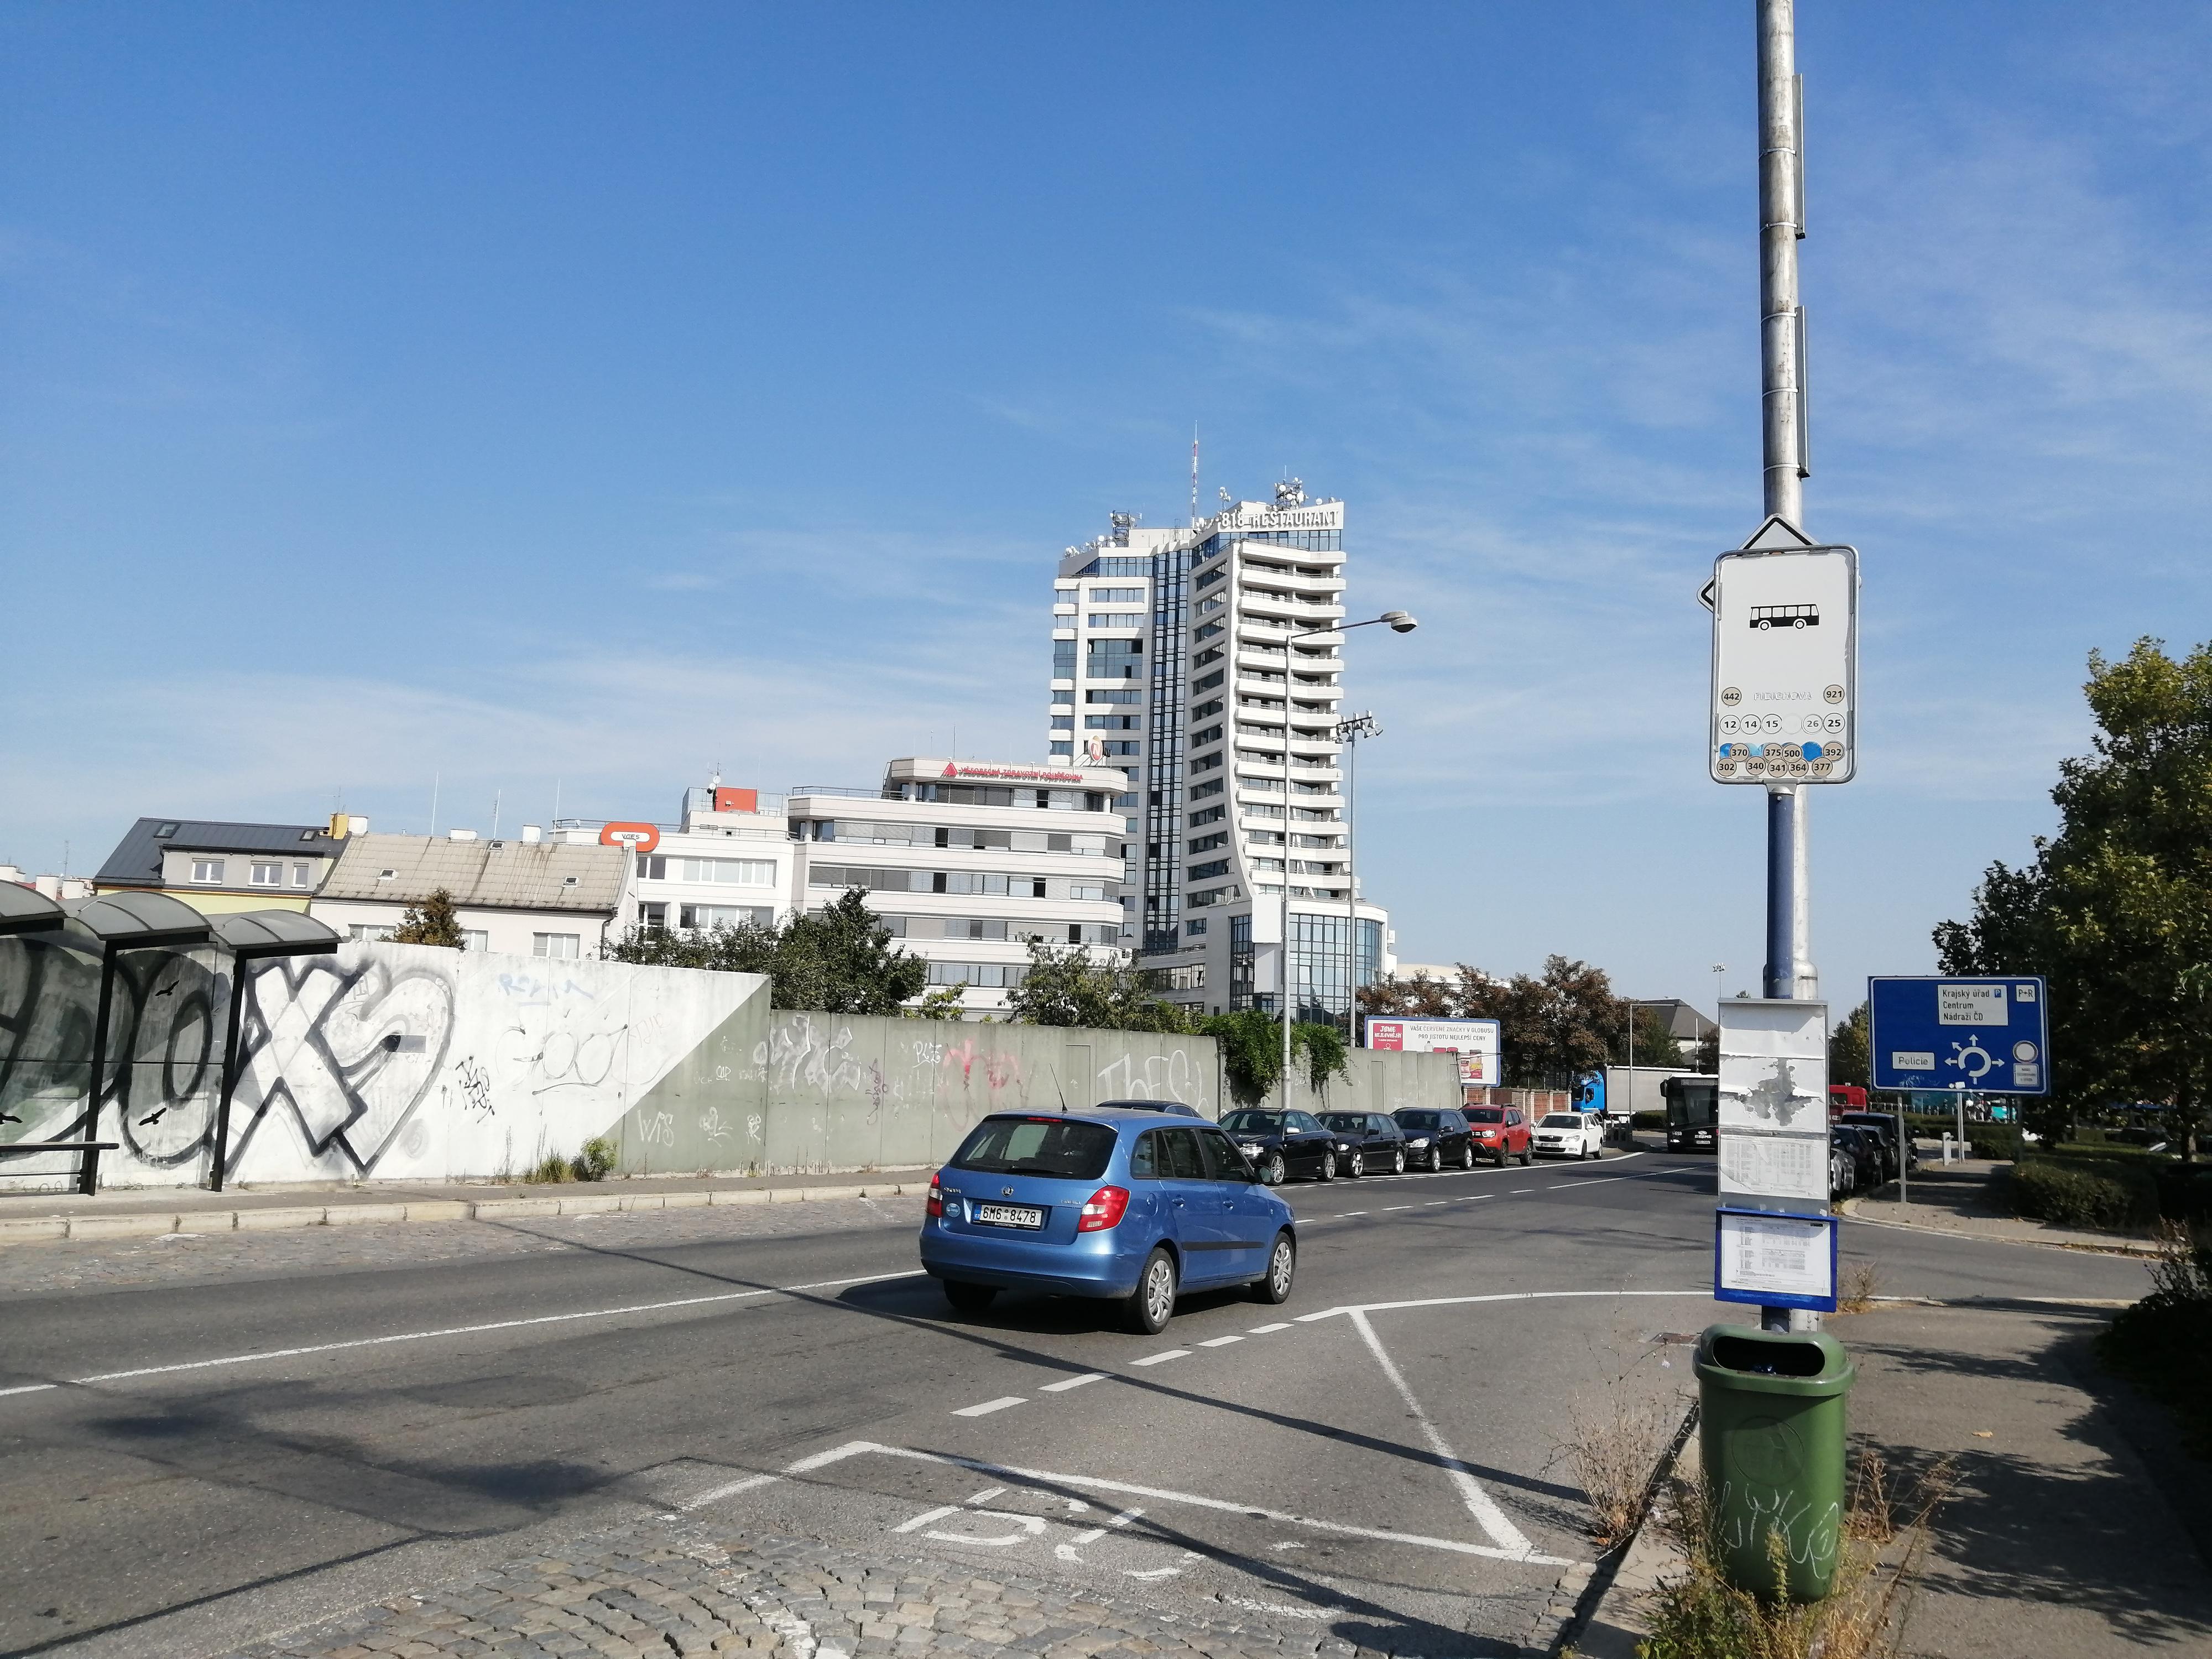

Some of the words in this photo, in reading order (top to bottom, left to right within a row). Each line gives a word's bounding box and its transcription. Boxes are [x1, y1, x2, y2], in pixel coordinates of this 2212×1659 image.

[1253, 509, 1339, 526] RESTAURANT
[1942, 989, 1970, 999] Krajský
[1973, 989, 1990, 998] úřad
[1943, 1001, 1974, 1009] Centrum
[1943, 1011, 1971, 1021] Nádraží
[1974, 1011, 1983, 1021] ČD
[1898, 1057, 1929, 1066] Policie
[983, 1207, 1002, 1220] 6M6
[1010, 1209, 1036, 1223] 8478
